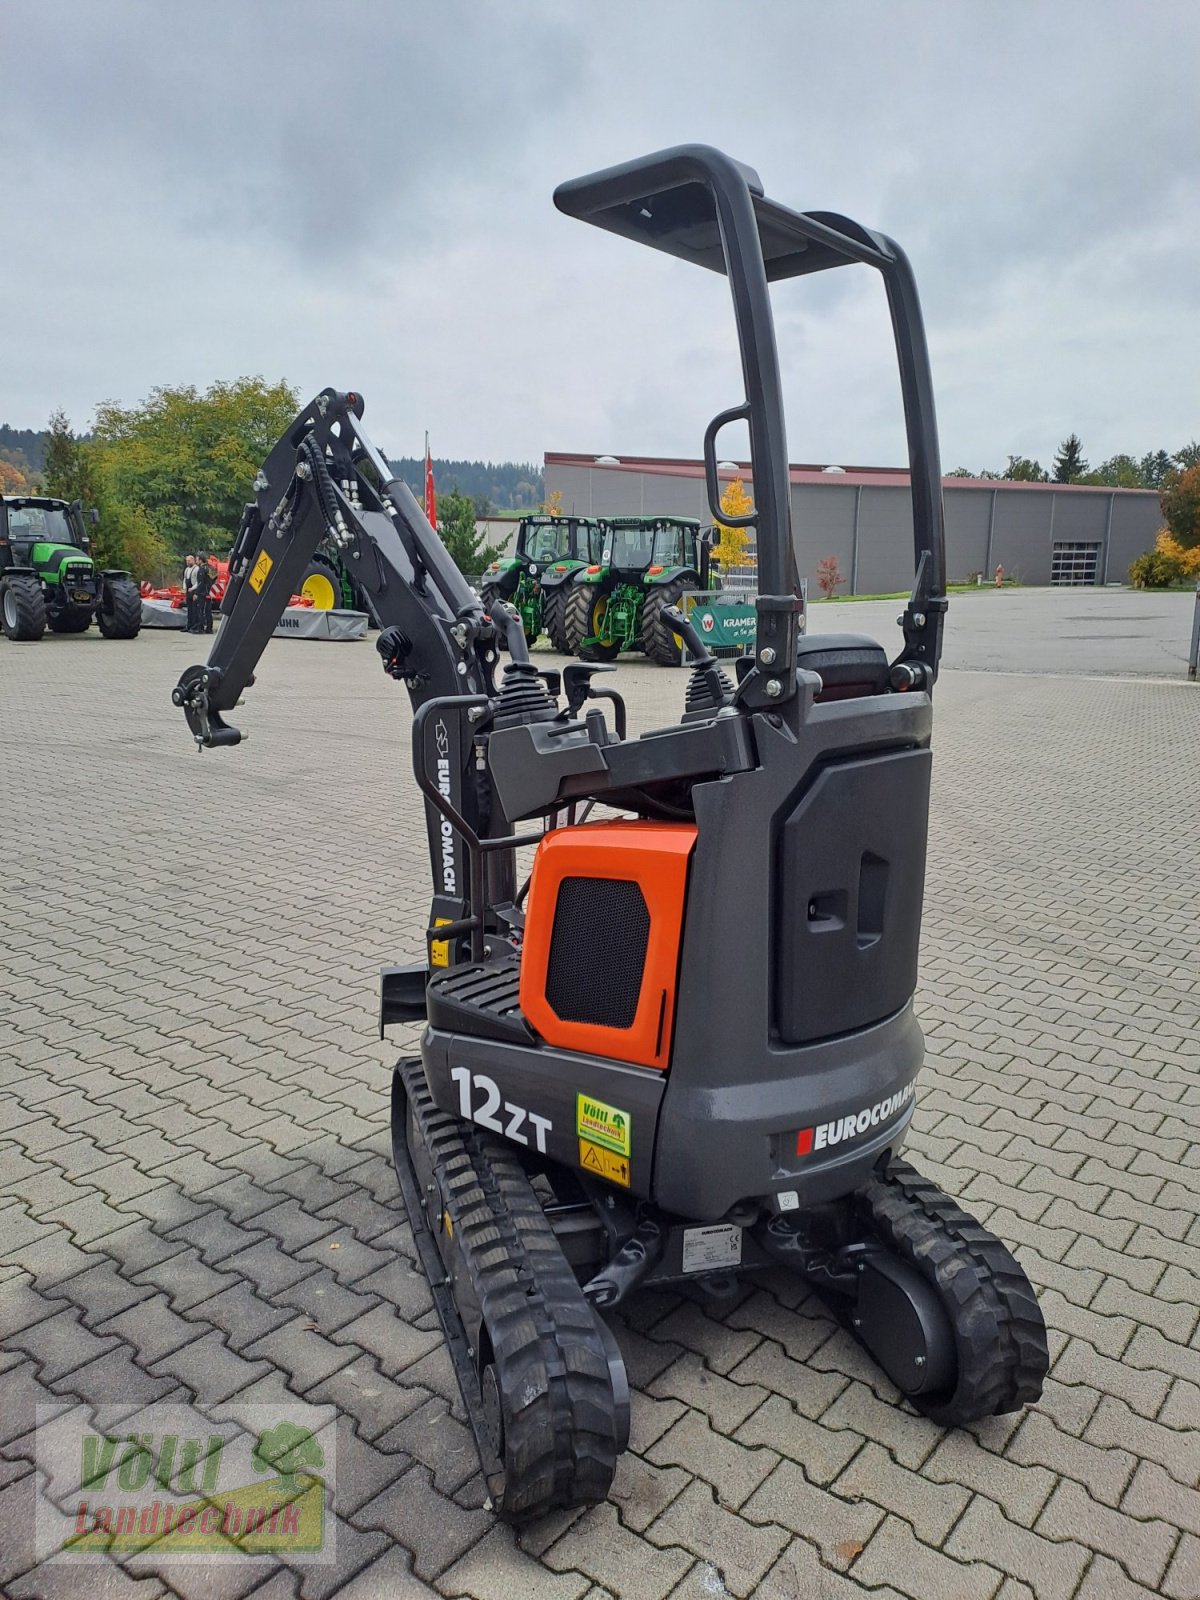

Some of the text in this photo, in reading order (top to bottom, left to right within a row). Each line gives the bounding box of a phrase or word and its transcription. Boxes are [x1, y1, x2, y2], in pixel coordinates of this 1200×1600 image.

[276, 618, 300, 628] UHN
[723, 617, 756, 628] KRAMER
[437, 759, 456, 893] EUROMACH
[584, 1103, 608, 1122] Völtl
